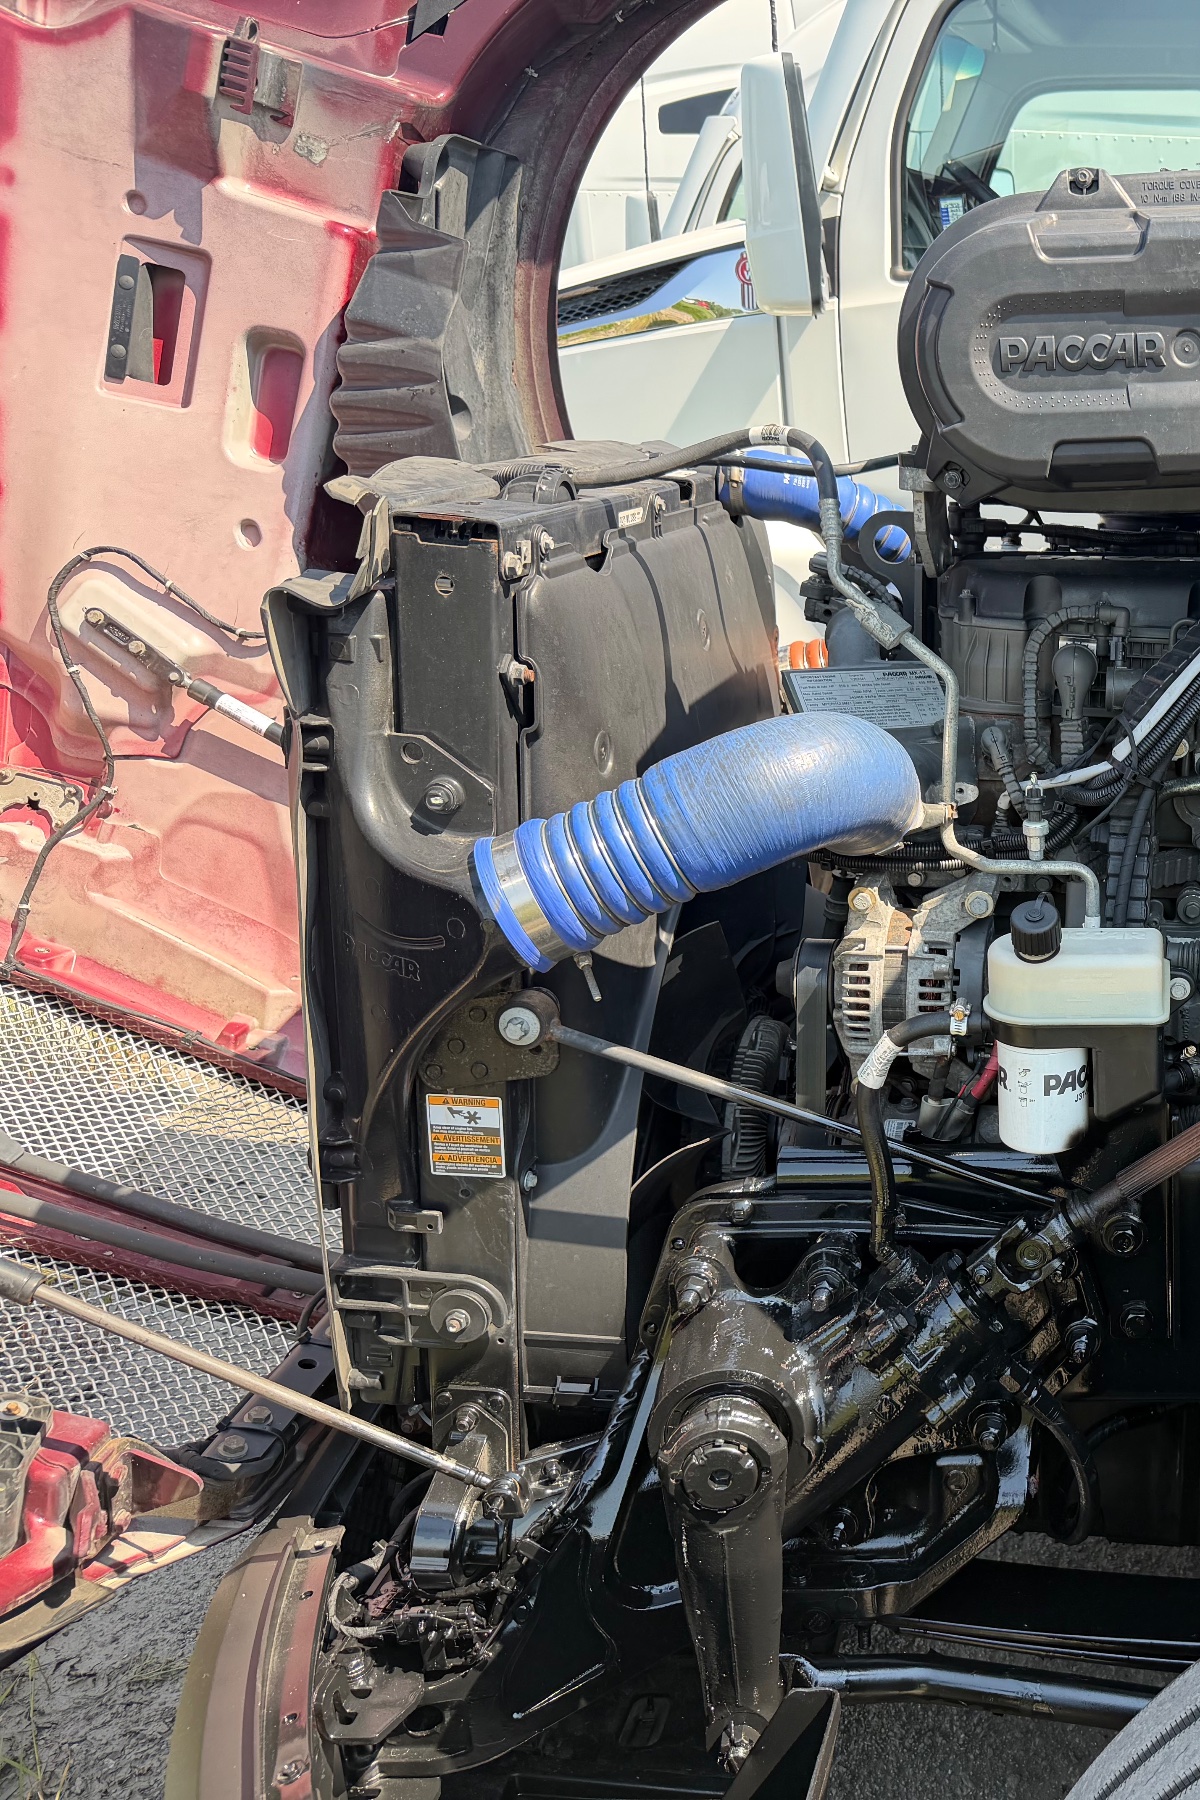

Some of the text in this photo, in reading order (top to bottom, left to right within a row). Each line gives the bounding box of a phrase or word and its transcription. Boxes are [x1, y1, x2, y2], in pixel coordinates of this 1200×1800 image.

[1142, 182, 1175, 192] TORQUE
[999, 332, 1167, 373] PACCAR
[452, 1097, 486, 1106] WARNING
[443, 1135, 500, 1144] AVERTISSEMENT
[448, 1155, 498, 1164] ADVERTENCIA
